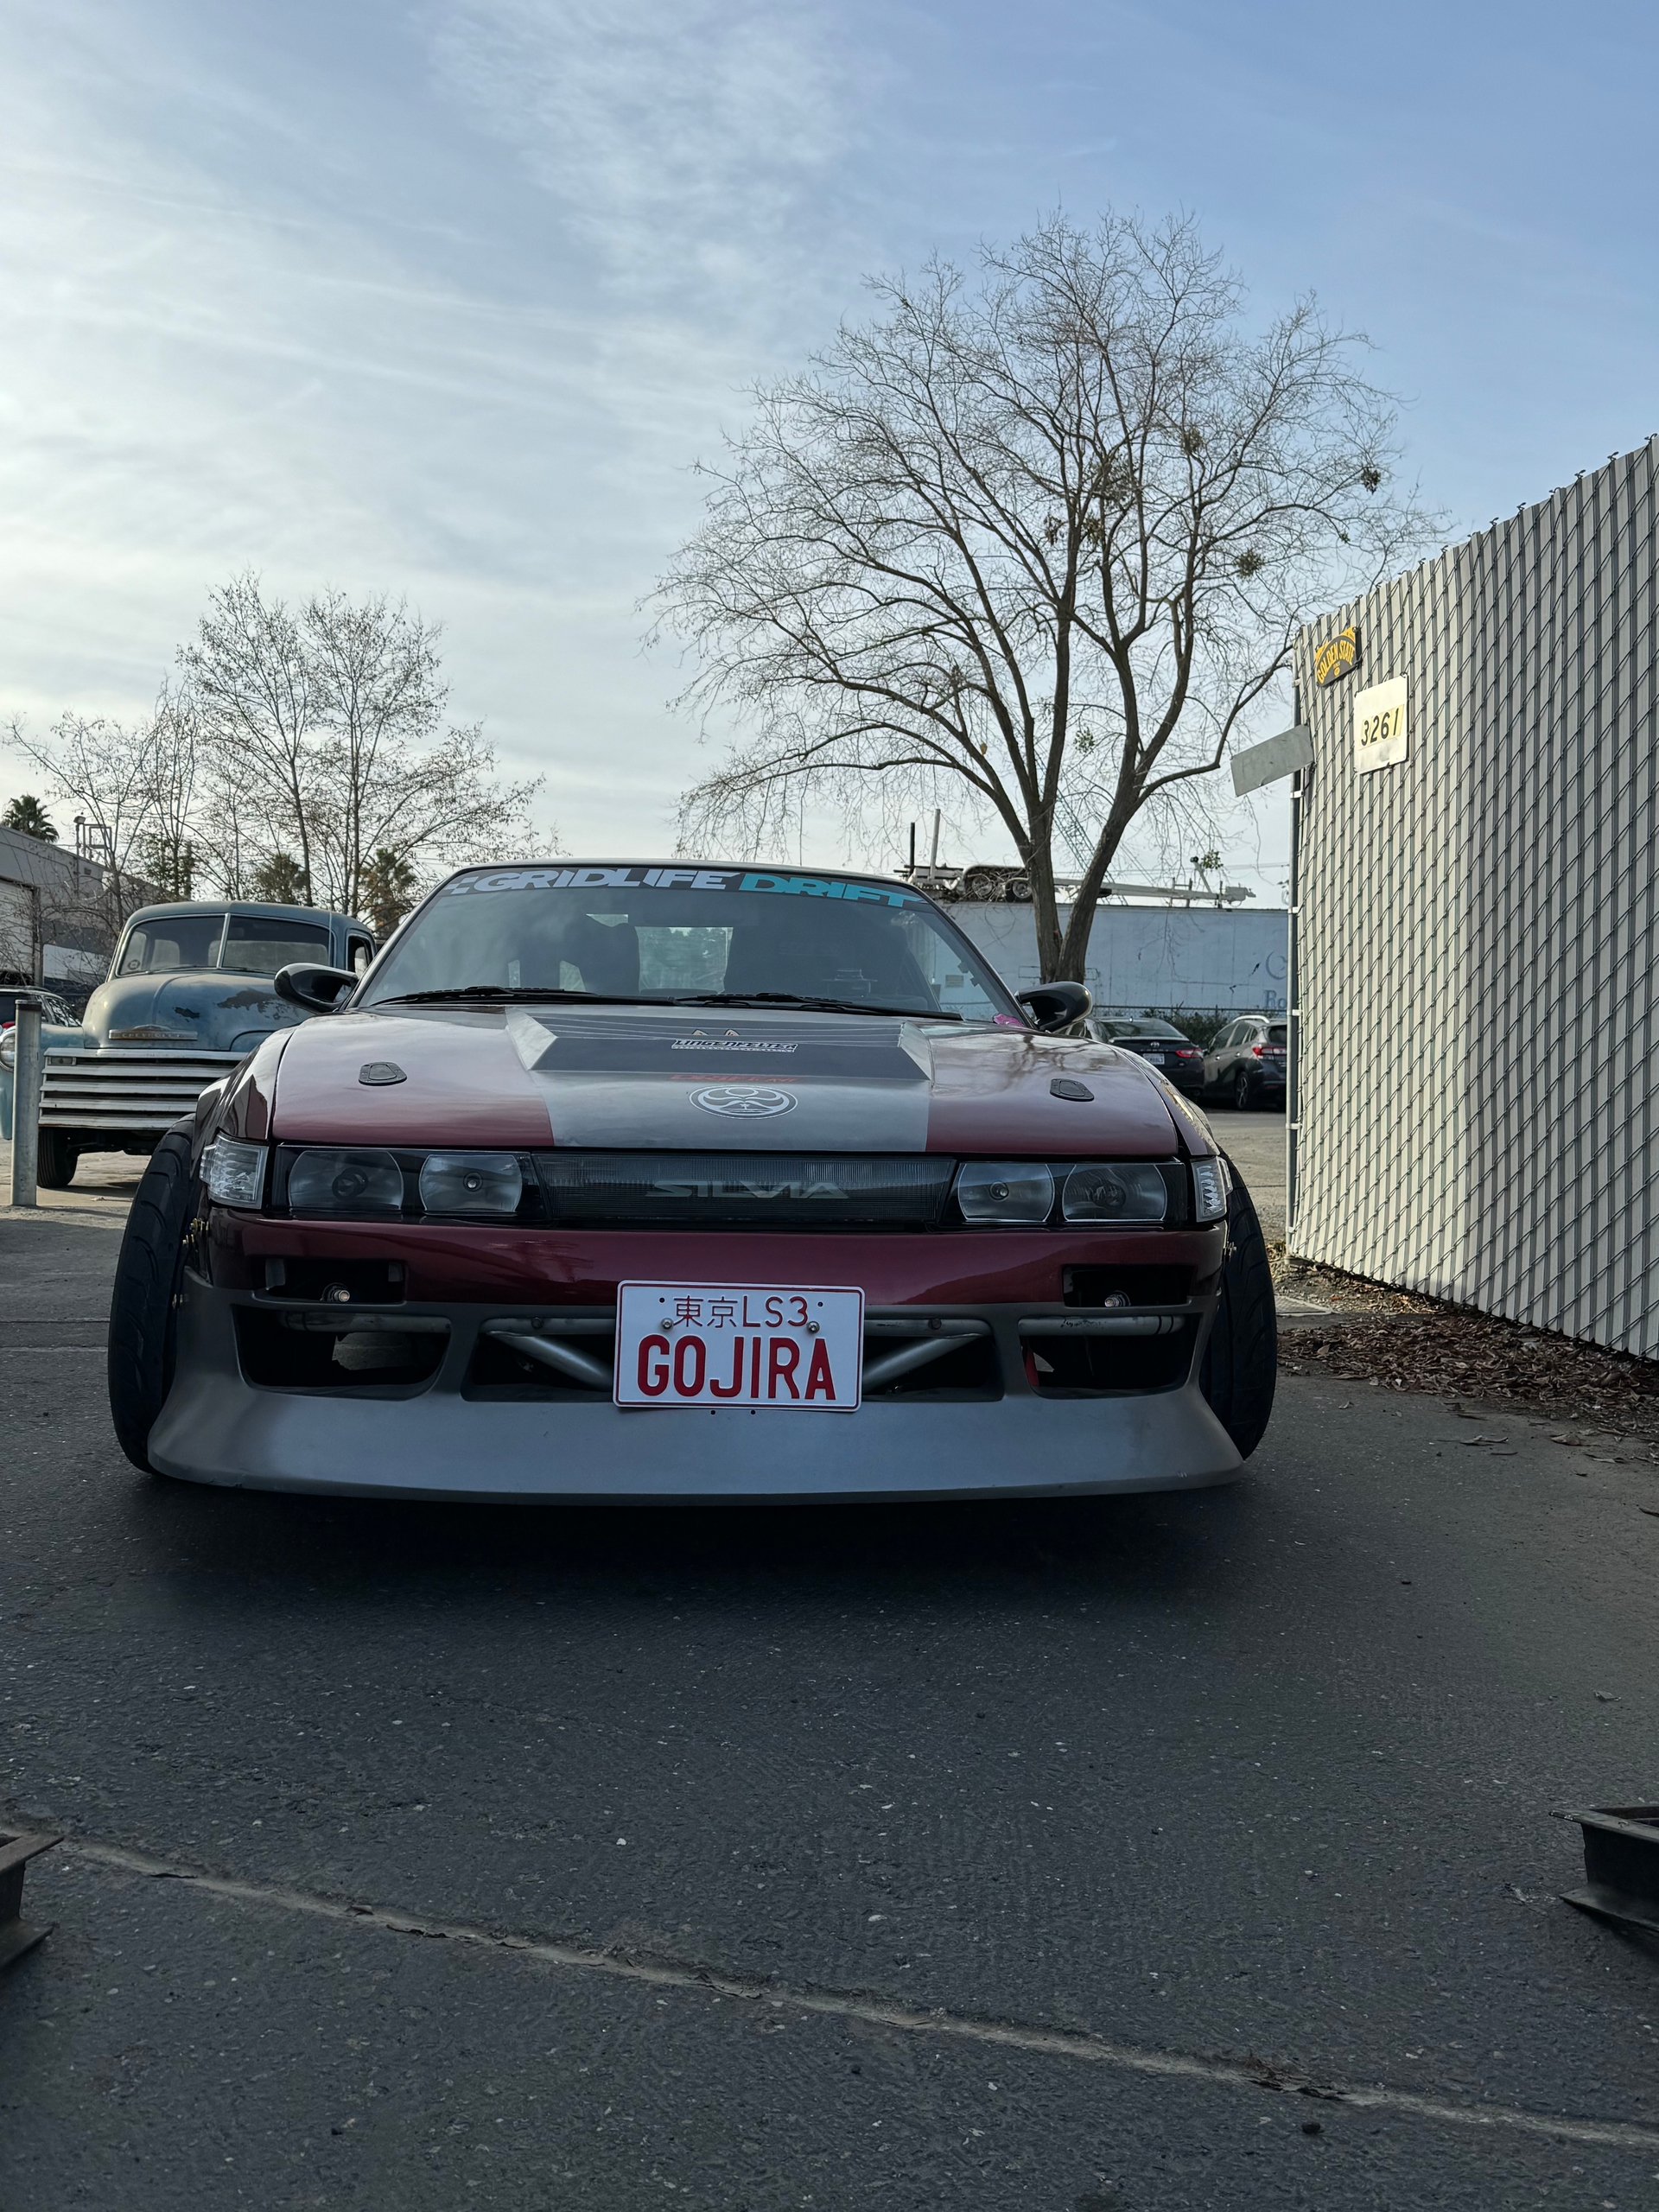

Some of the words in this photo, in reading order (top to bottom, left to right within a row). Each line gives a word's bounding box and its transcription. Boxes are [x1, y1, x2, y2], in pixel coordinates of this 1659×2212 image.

[1316, 641, 1338, 684] GOLDEN
[1338, 639, 1356, 666] STATE
[1360, 707, 1400, 747] 3261
[473, 868, 740, 892] GRIDLIFE
[739, 873, 923, 907] DRIFT
[644, 1179, 849, 1199] SILVIA
[637, 1333, 836, 1401] GOJIRA
